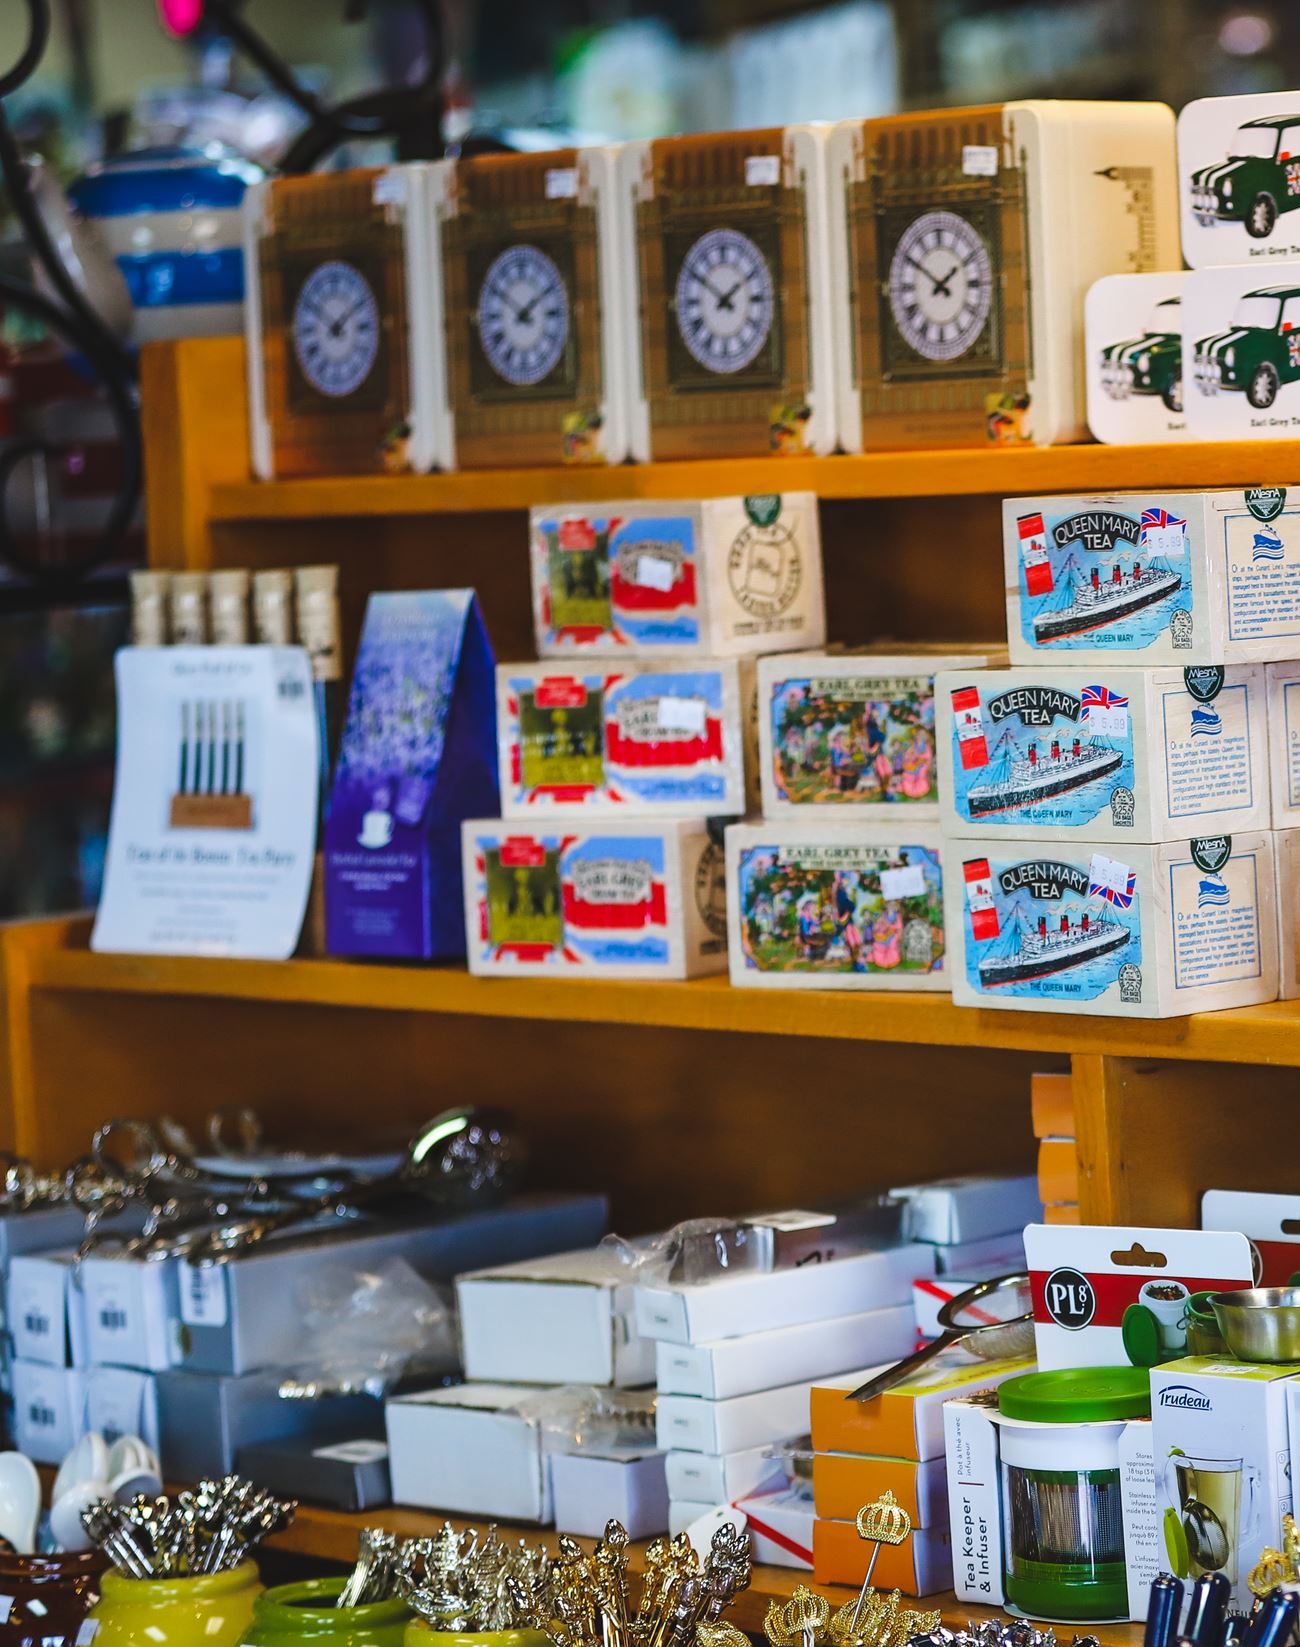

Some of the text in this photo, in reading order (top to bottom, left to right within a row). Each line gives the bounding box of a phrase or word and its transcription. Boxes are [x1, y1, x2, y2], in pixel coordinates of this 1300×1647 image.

[1055, 515, 1140, 544] QUEEN MARY
[1084, 534, 1112, 548] TEA
[1096, 634, 1116, 643] QUEEN
[1118, 634, 1134, 642] MARY
[818, 680, 920, 690] EARL GREY TEA
[991, 691, 1079, 718] QUEEN MARY
[1022, 709, 1050, 724] TEA
[1056, 810, 1072, 818] MARY
[787, 849, 890, 858] EARL GREY TEA
[1002, 864, 1088, 891] QUEEN MARY
[1032, 883, 1060, 898] TEA
[1030, 982, 1082, 992] THE QUEEN MARY
[1051, 1284, 1086, 1314] PL8
[1160, 1393, 1211, 1409] Trudeau
[1136, 1452, 1152, 1460] Stores
[963, 1496, 976, 1591] Tea Keeper
[977, 1516, 991, 1592] & Infuser
